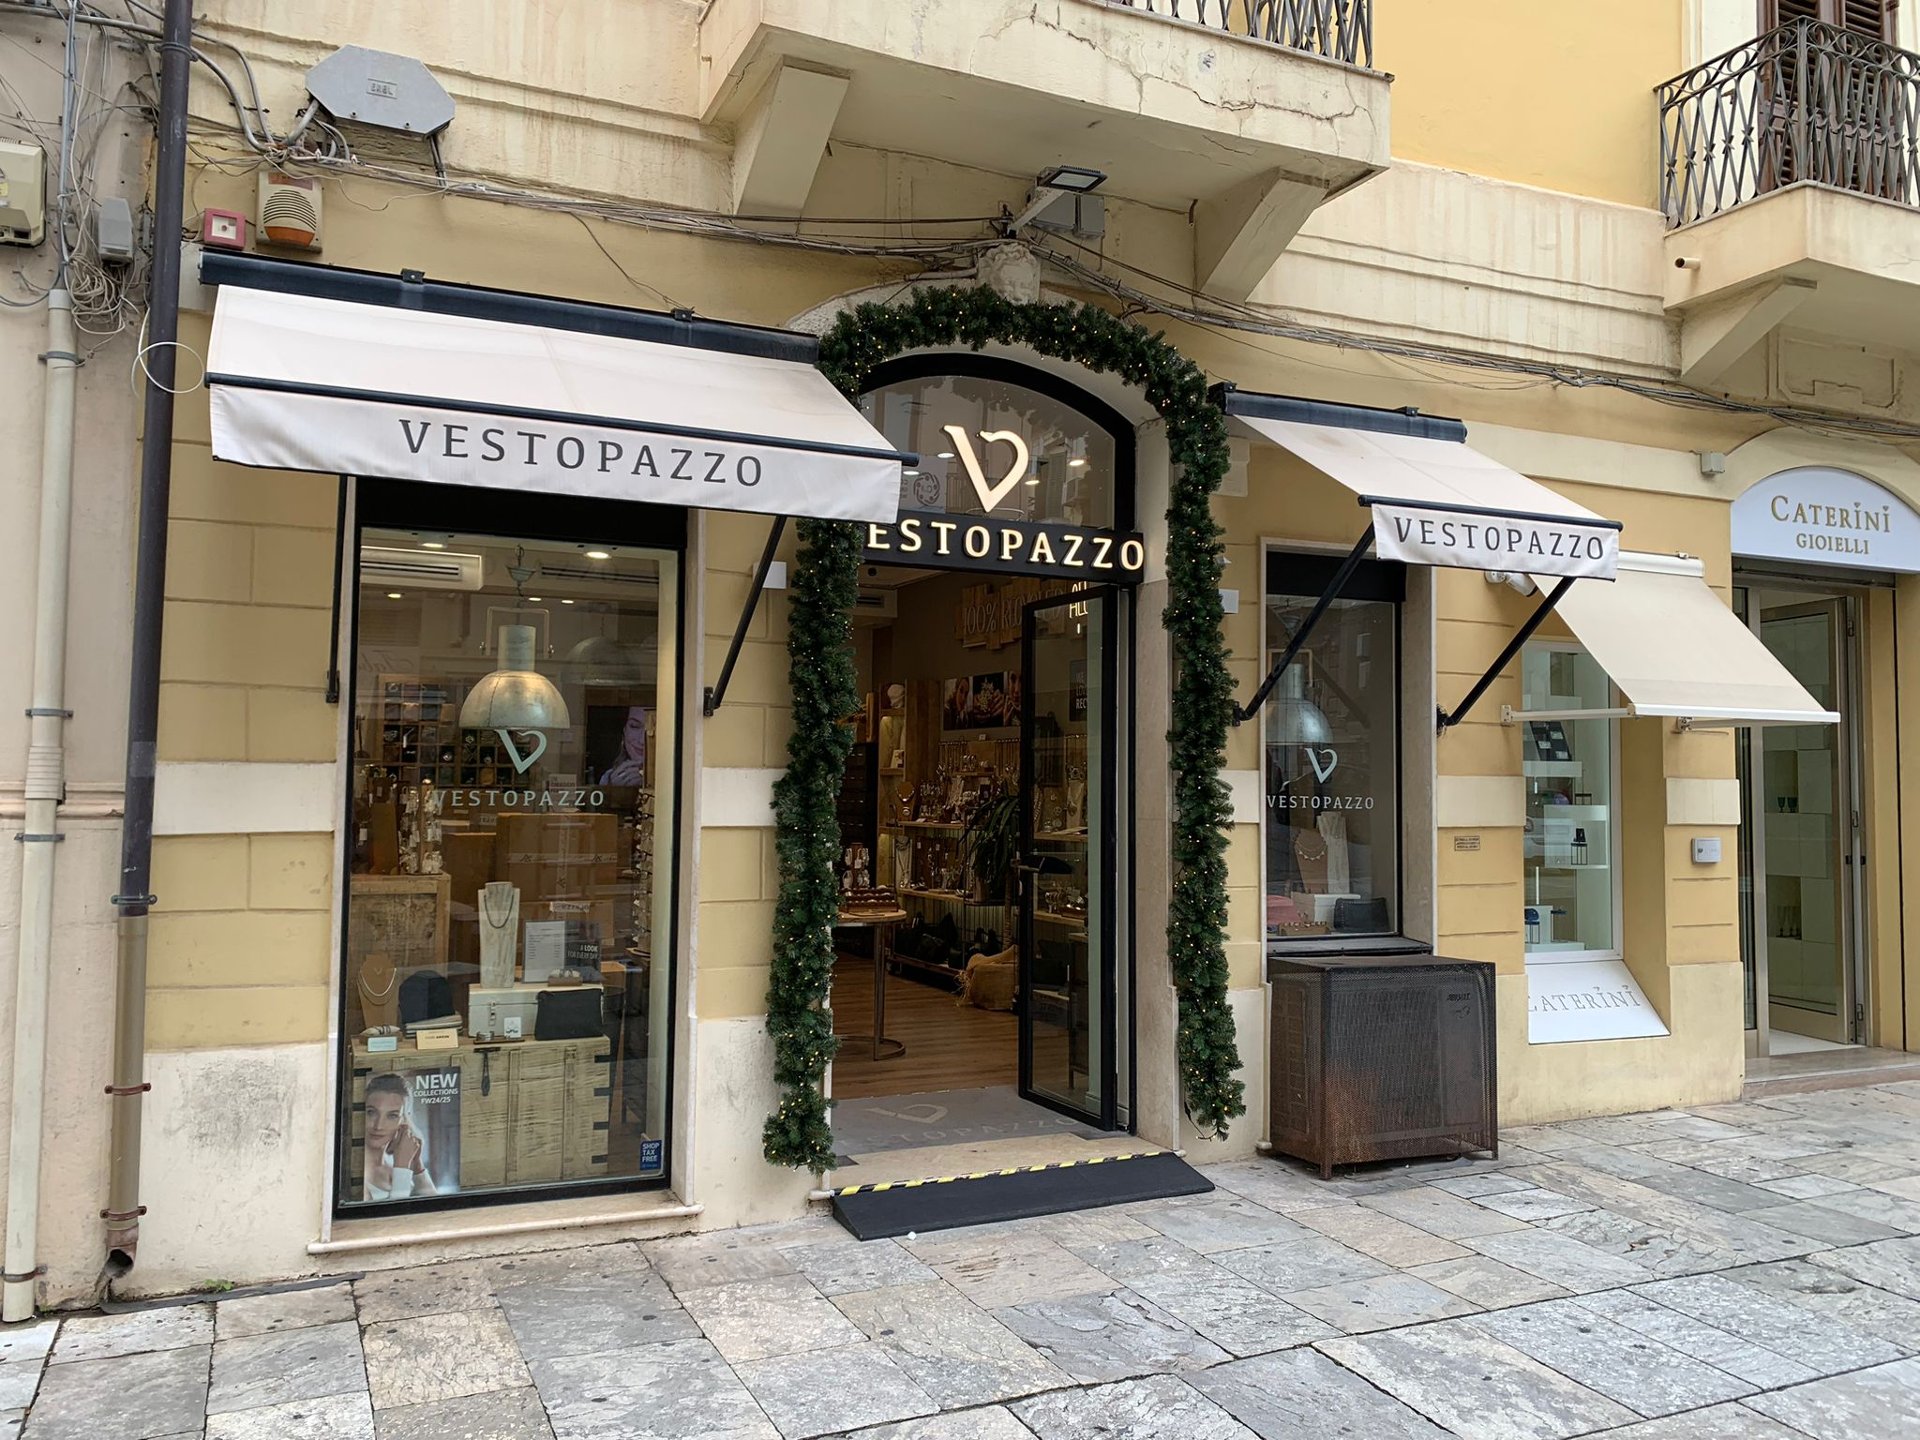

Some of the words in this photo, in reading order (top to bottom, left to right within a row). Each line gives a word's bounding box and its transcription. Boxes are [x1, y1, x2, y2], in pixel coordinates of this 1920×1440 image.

[399, 418, 762, 487] VESTOPAZZO
[867, 518, 1145, 571] ESTOPAZZO
[1393, 516, 1604, 560] VESTOPAZZO
[1796, 532, 1870, 555] GIOIELLI
[963, 602, 997, 634] 100%
[433, 790, 604, 807] VESTOPAZZO
[1266, 795, 1374, 810] VESTOPAZZO
[584, 944, 598, 952] LOOK
[416, 1073, 458, 1090] NEW
[413, 1088, 458, 1097] COLLECTIONS
[420, 1096, 451, 1104] FW24/25
[642, 1142, 660, 1150] SHOP
[642, 1155, 658, 1163] FREE
